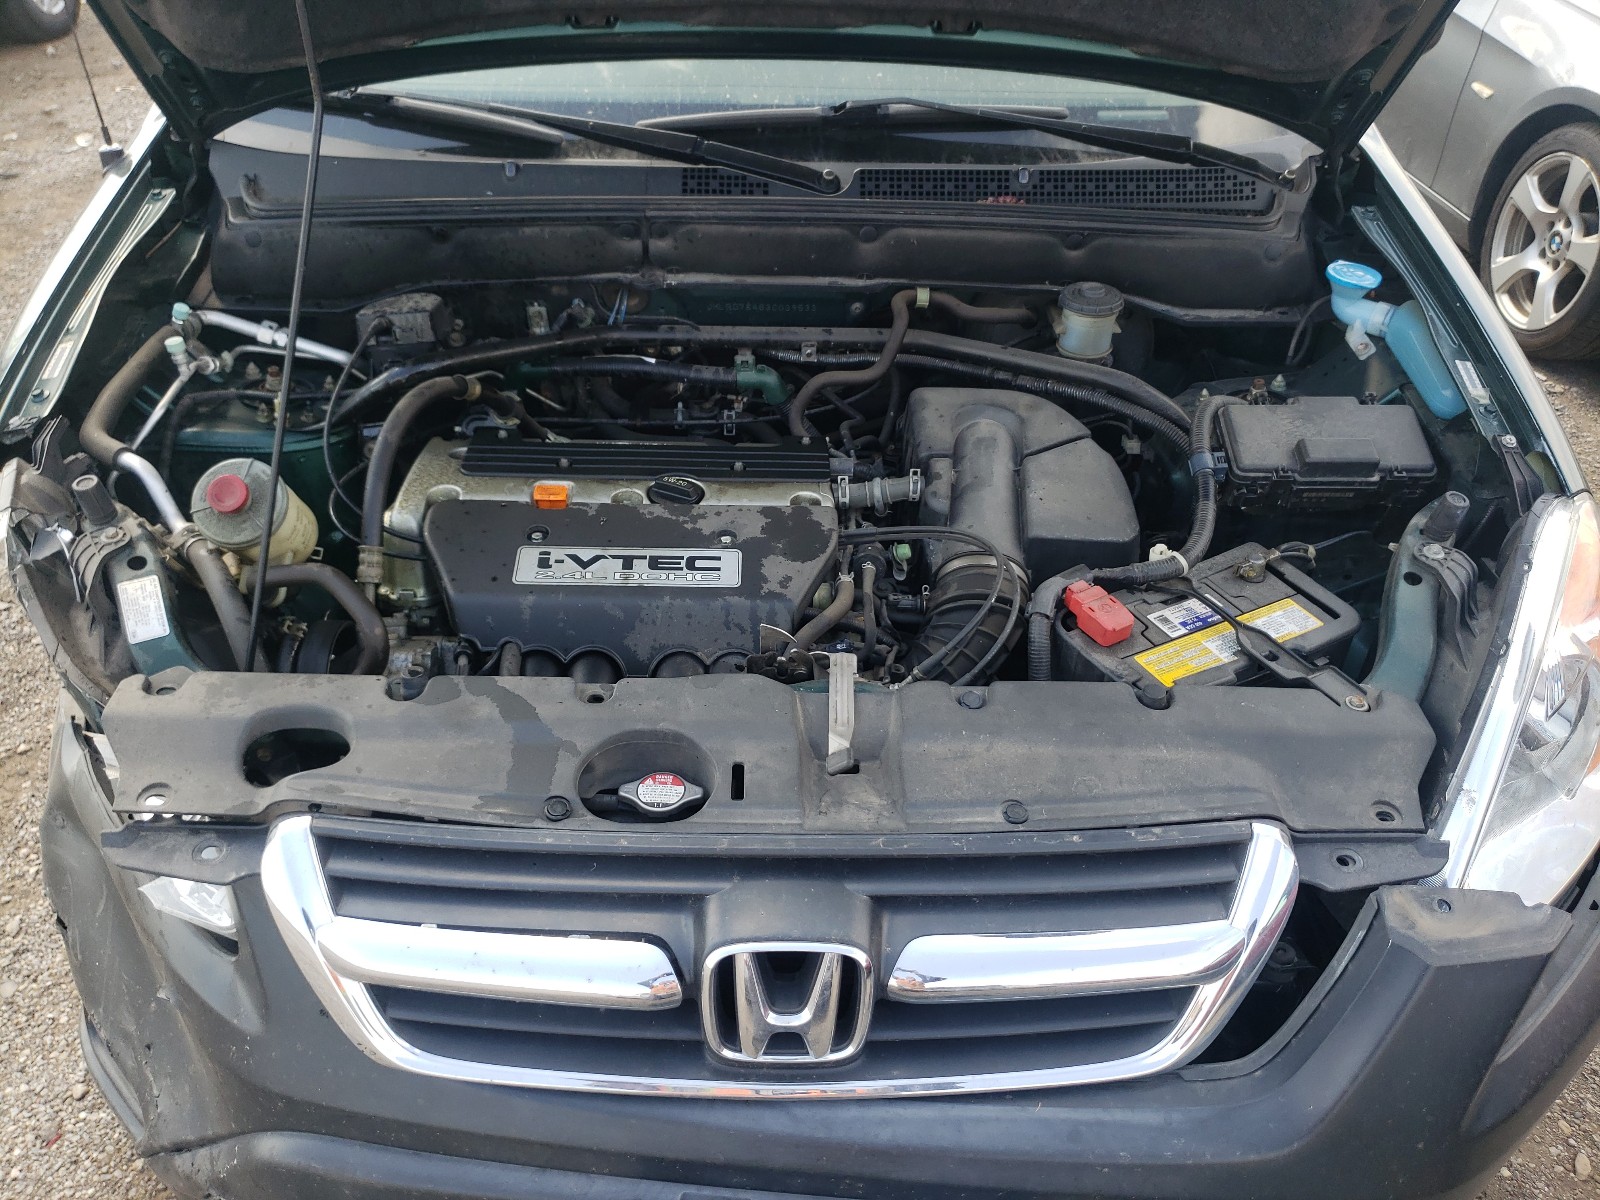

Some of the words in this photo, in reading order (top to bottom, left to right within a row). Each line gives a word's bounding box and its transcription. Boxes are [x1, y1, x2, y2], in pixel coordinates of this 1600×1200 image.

[537, 551, 722, 571] i-VTEC
[535, 571, 607, 580] 2.4L
[613, 571, 721, 581] DOHC
